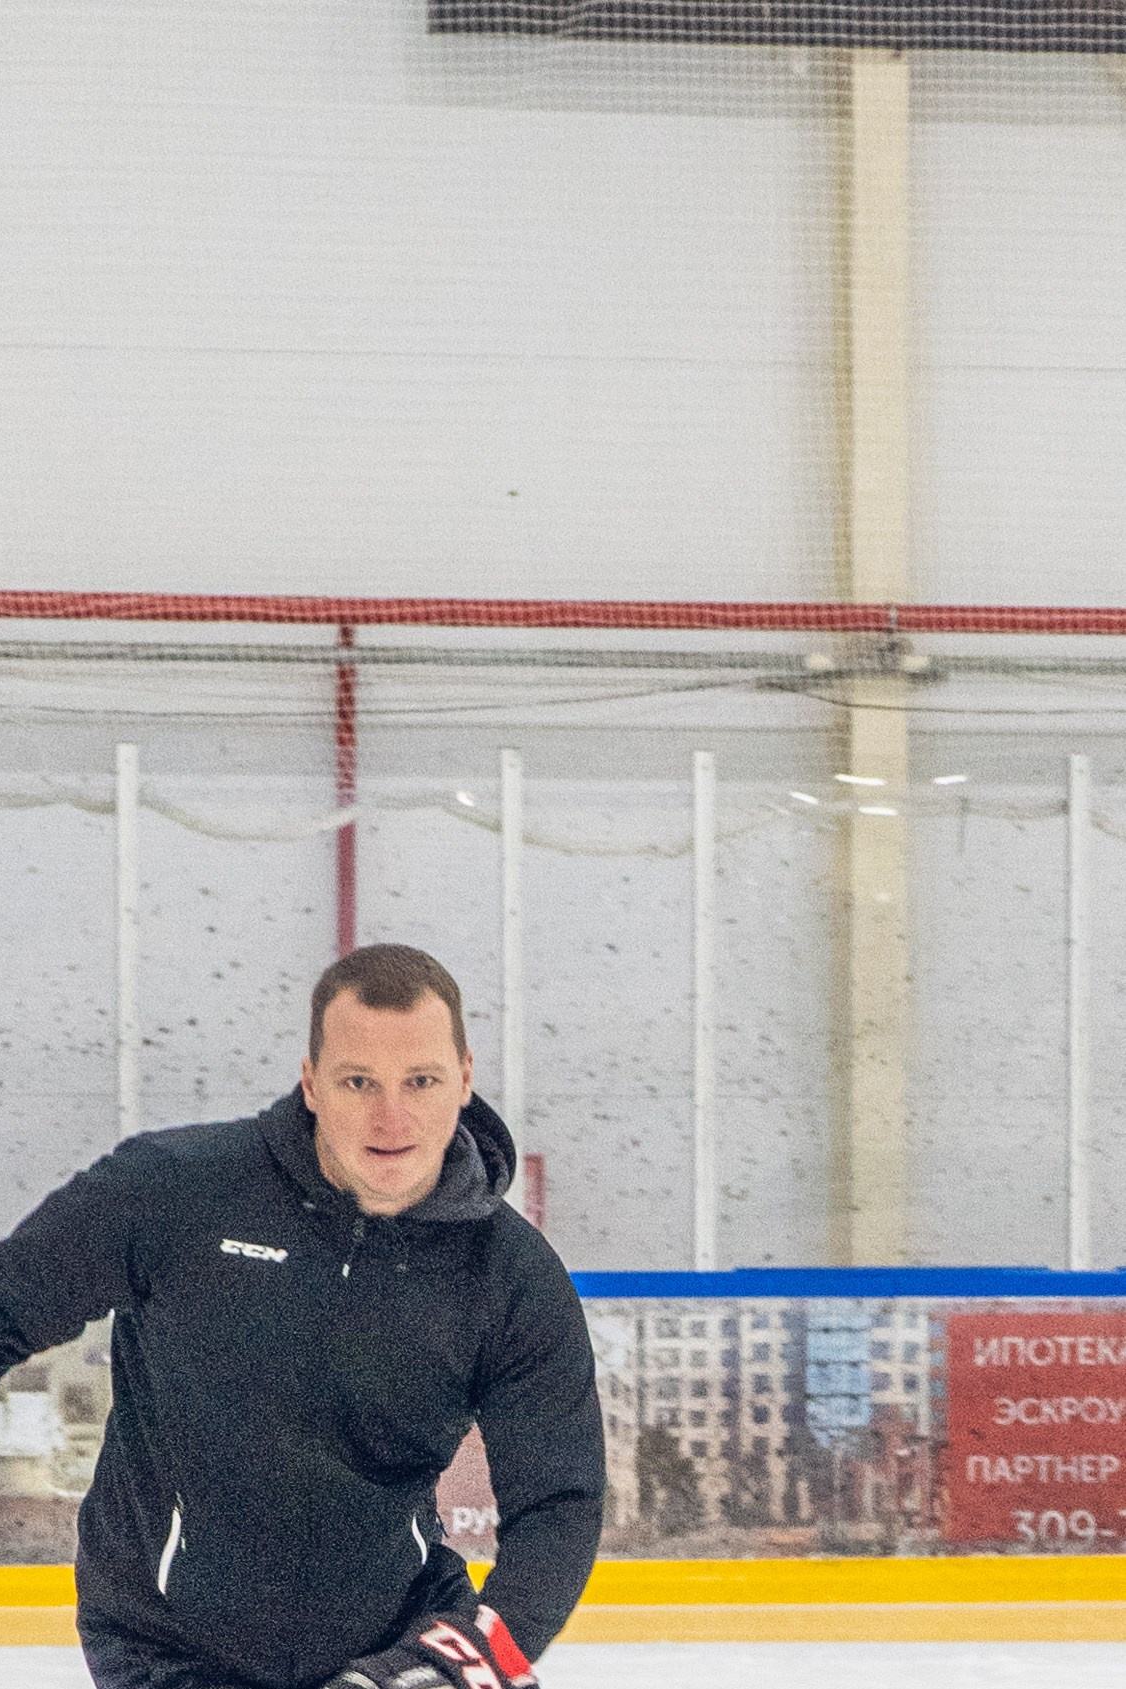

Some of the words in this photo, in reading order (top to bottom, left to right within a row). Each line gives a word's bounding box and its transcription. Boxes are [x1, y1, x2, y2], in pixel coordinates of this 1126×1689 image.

[219, 1239, 289, 1264] CCM
[966, 1454, 1121, 1483] ПАРТНЕР
[1010, 1509, 1126, 1548] 309-
